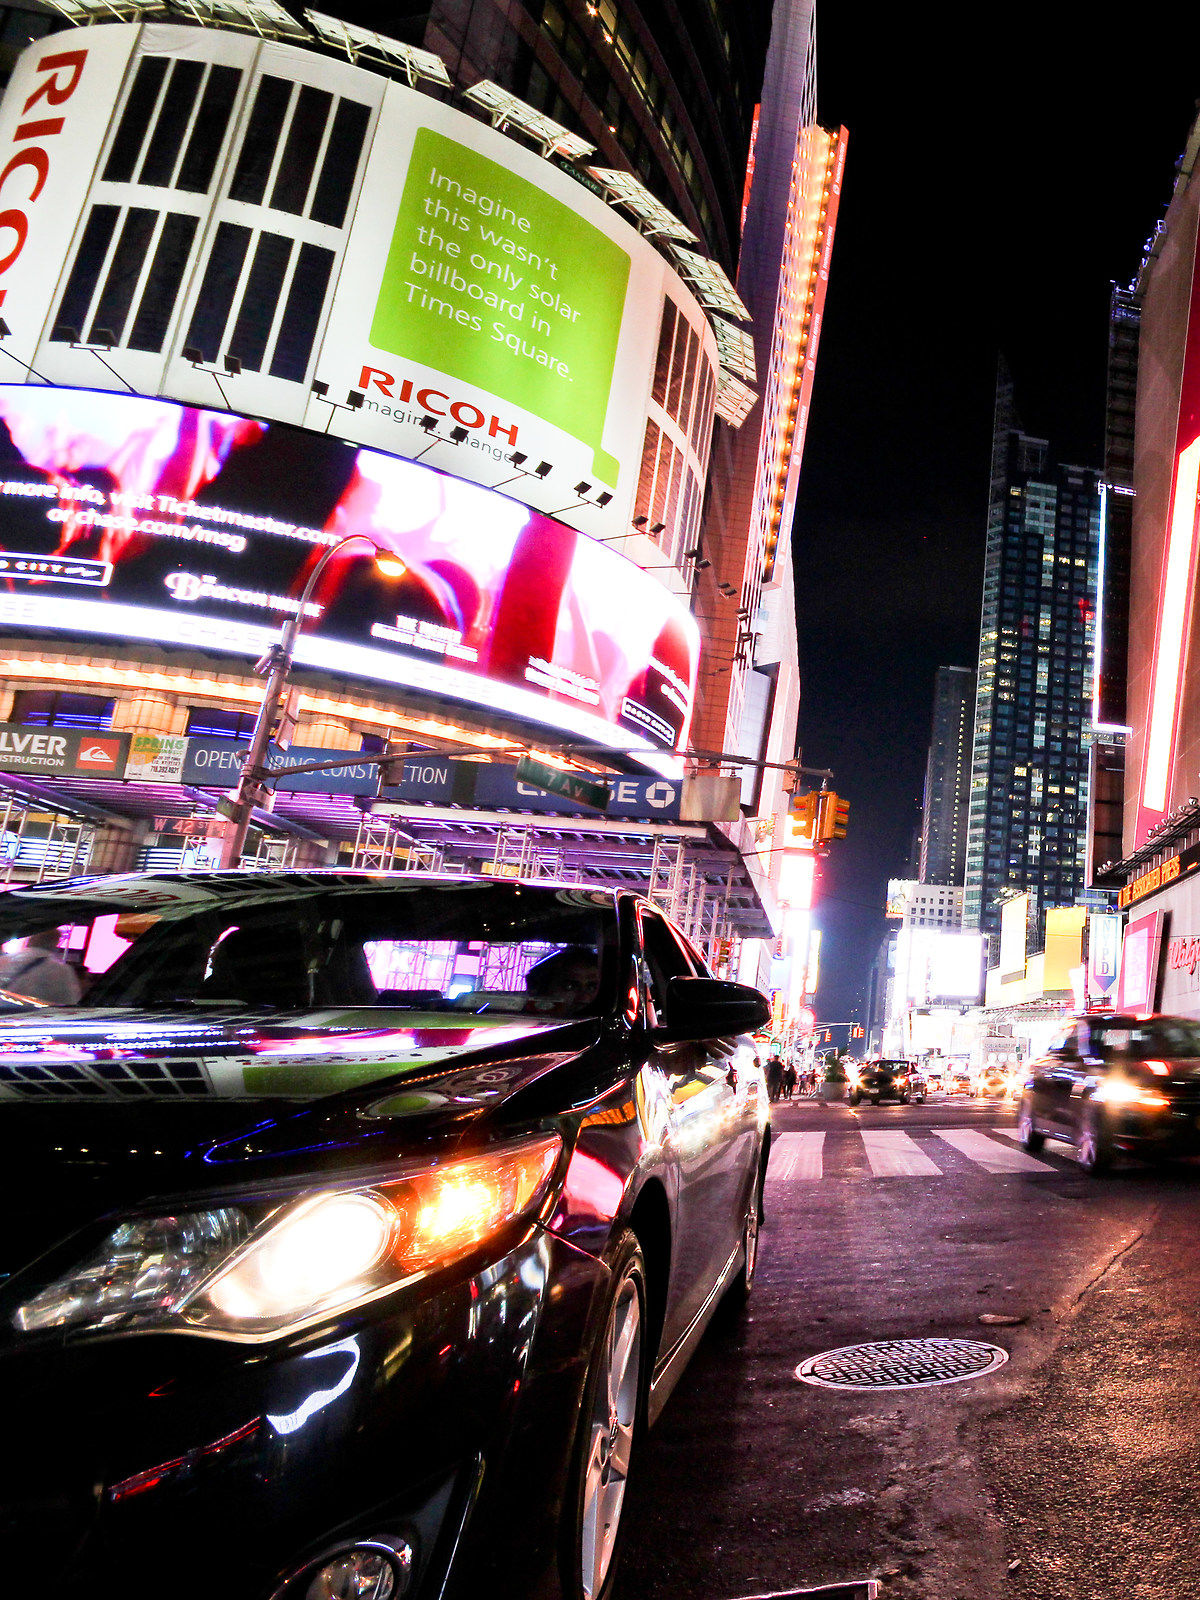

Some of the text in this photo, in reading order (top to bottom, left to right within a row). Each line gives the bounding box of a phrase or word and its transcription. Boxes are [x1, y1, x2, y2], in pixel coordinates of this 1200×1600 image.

[0, 49, 89, 307] RICO
[429, 167, 531, 233] Imagine
[417, 225, 581, 323] the only solar
[423, 197, 558, 280] this wasn't
[404, 281, 574, 382] Times Square.
[409, 252, 552, 337] billboard in
[358, 365, 519, 447] RICOH
[194, 749, 241, 769] OPEN
[547, 771, 557, 786] 7
[154, 818, 168, 831] W
[172, 819, 194, 833] 42
